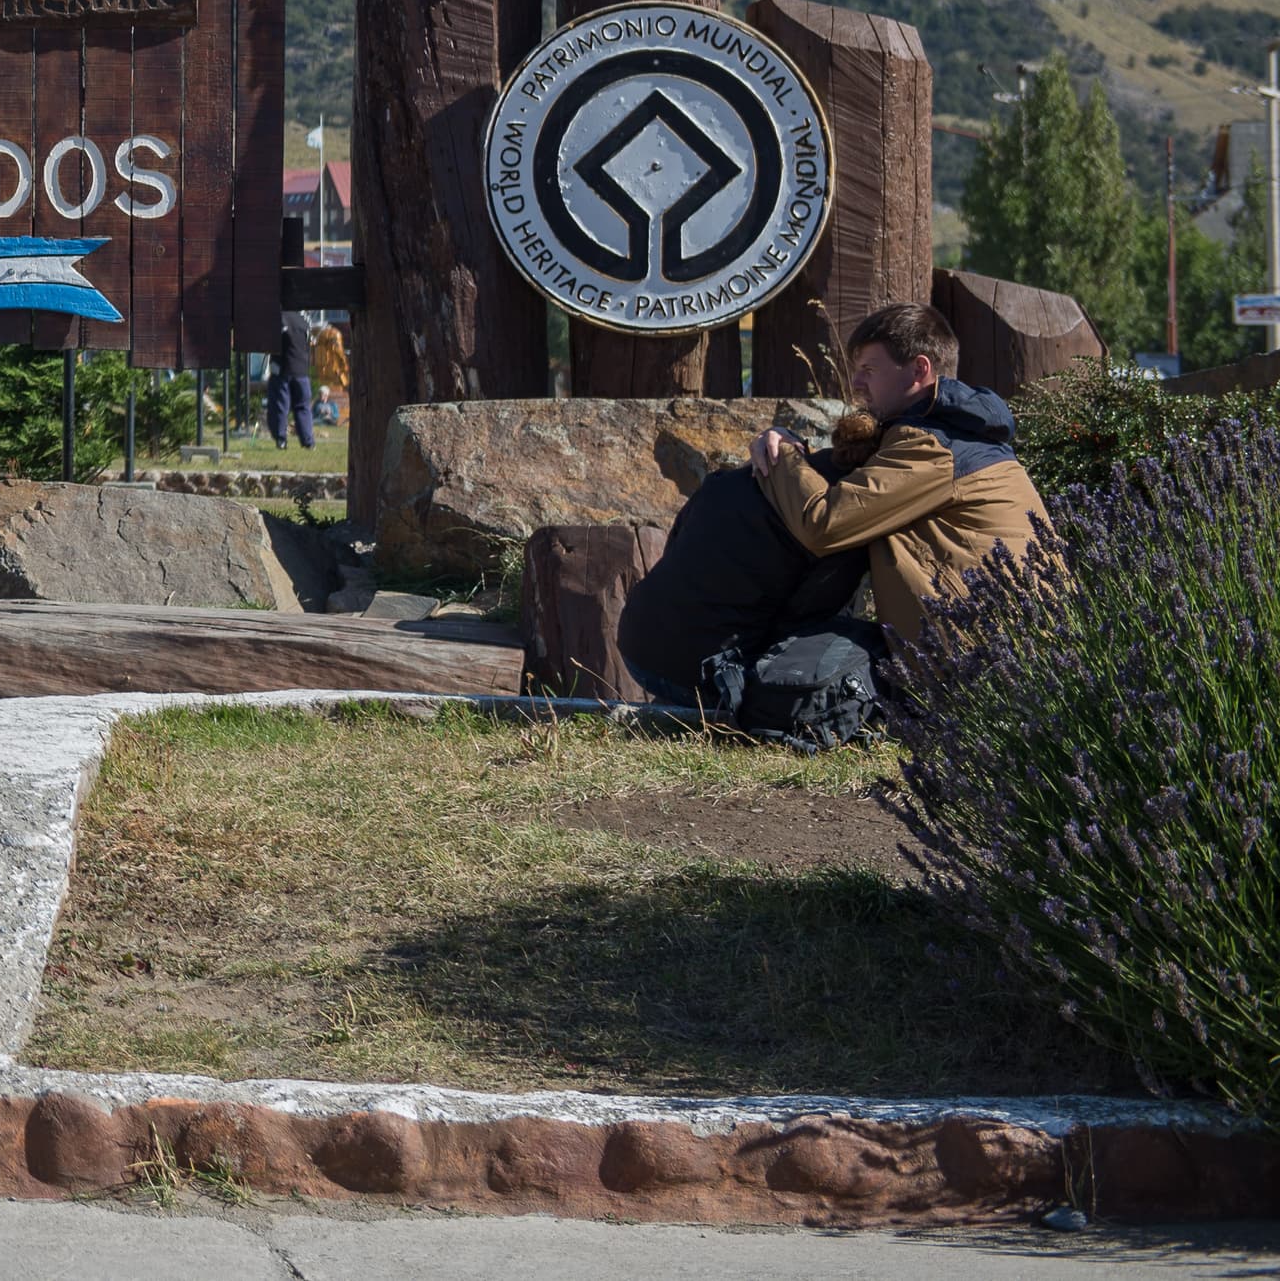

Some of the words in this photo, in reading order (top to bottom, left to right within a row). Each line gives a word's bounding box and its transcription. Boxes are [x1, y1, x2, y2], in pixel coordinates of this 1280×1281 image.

[521, 15, 677, 102] PATRIMONIO
[683, 19, 794, 108] MUNDIAL
[500, 120, 527, 215] WORLD
[634, 244, 789, 320] PATRIMOINE
[778, 117, 819, 248] MONDIAL
[512, 221, 613, 312] HERITAGE
